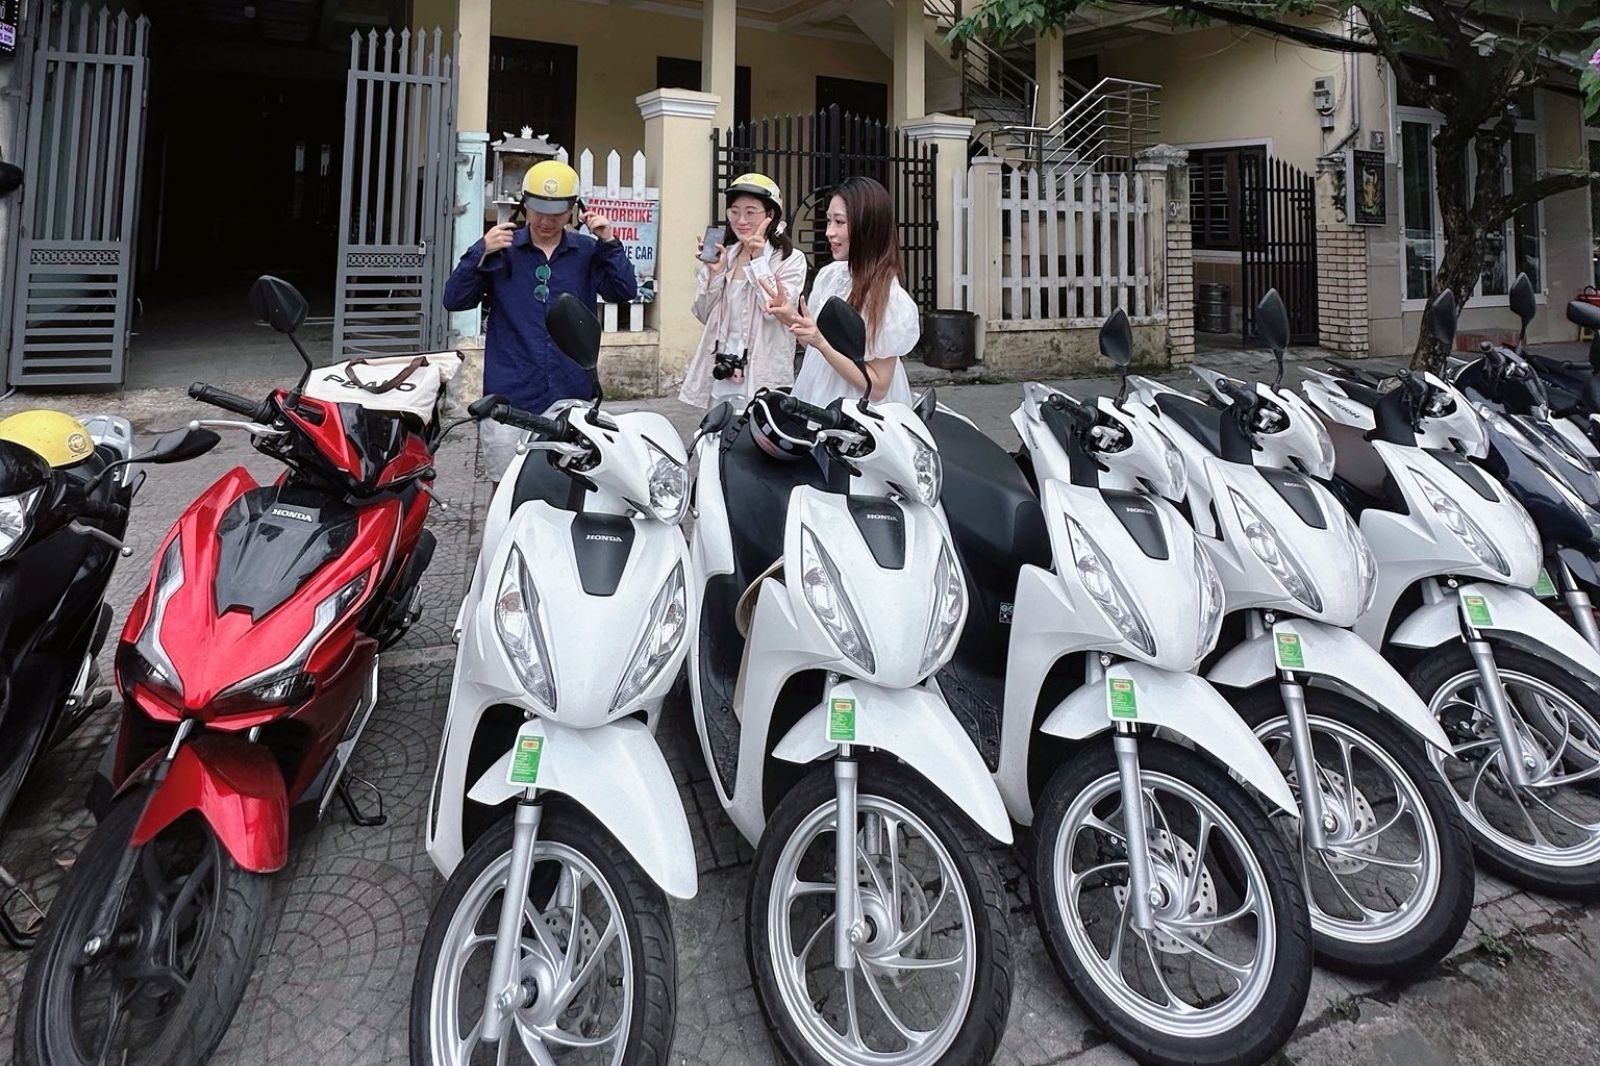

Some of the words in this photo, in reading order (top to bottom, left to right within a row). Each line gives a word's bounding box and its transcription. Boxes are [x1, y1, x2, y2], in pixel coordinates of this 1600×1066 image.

[611, 227, 640, 241] NTAL
[635, 246, 653, 260] CAR
[323, 374, 417, 392] PEAO
[271, 508, 313, 522] HONDA
[866, 513, 899, 522] HONDA
[585, 534, 624, 543] HONDA
